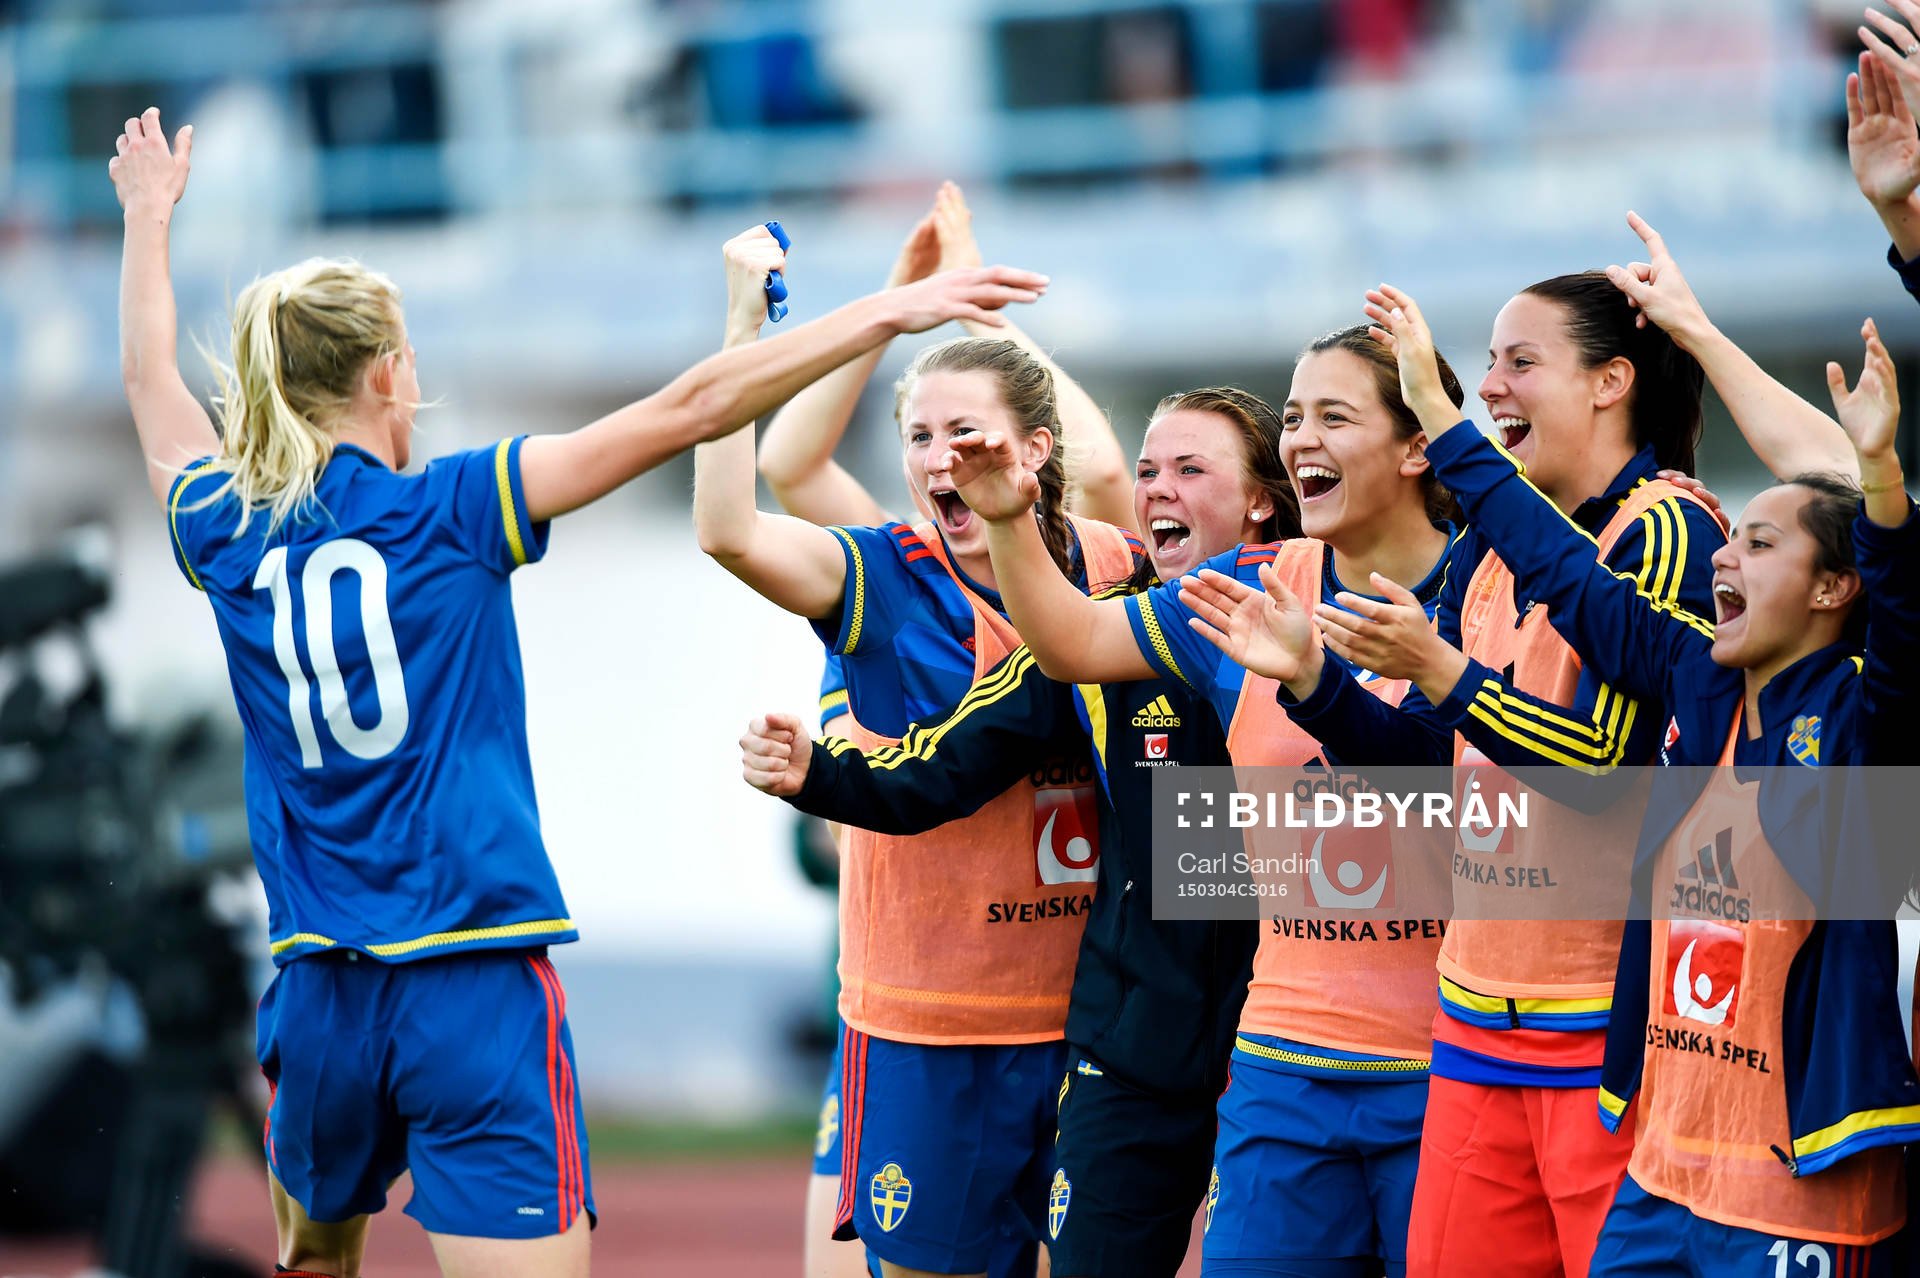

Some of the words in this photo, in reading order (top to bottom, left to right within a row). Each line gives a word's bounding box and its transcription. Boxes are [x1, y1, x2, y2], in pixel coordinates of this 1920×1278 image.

[253, 538, 409, 768] 10
[1131, 714, 1181, 728] adidas
[1504, 866, 1558, 888] SPEL
[987, 894, 1093, 923] SVENSKA
[1273, 913, 1378, 942] SVENSKA
[1720, 1041, 1771, 1074] SPEL
